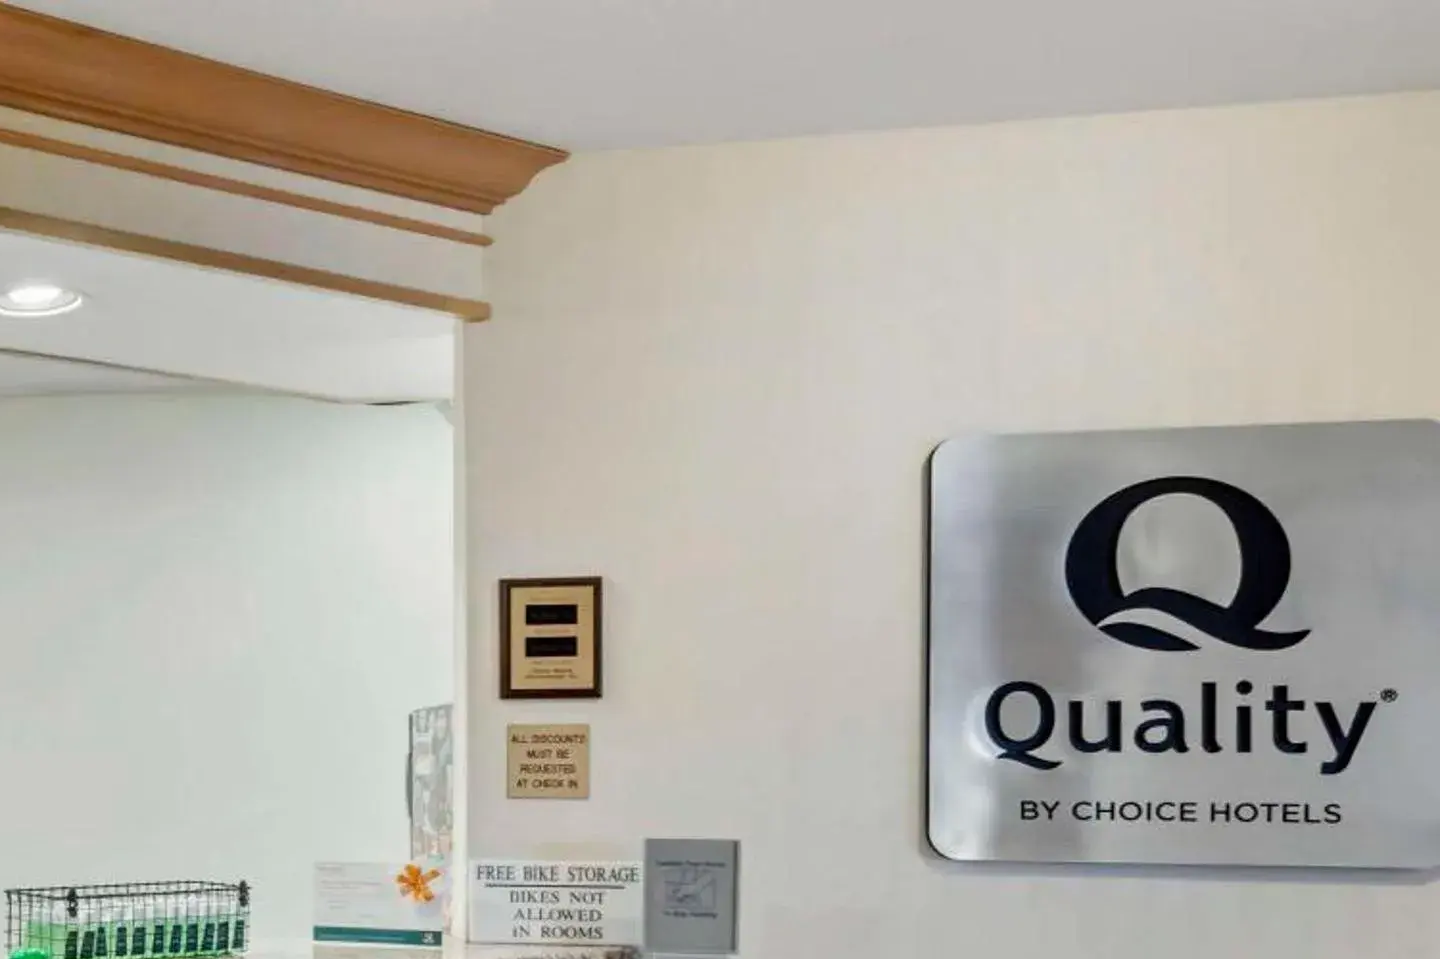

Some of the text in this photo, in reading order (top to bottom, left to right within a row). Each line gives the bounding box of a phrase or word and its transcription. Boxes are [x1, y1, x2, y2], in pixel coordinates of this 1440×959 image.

[1065, 475, 1312, 652] Q
[984, 679, 1378, 775] Quality
[511, 733, 586, 744] ALL DISCOUNTS
[526, 748, 571, 759] MUST BE
[520, 763, 576, 774] REQUESTED
[516, 778, 578, 789] AT CHECK IN
[1020, 800, 1342, 824] BY CHOICE HOTELS
[477, 865, 640, 883] FREE BIKE STORAGE
[510, 890, 606, 905] BIKES NOT
[512, 908, 603, 922] ALLOWED
[512, 925, 604, 940] IN ROOMS
